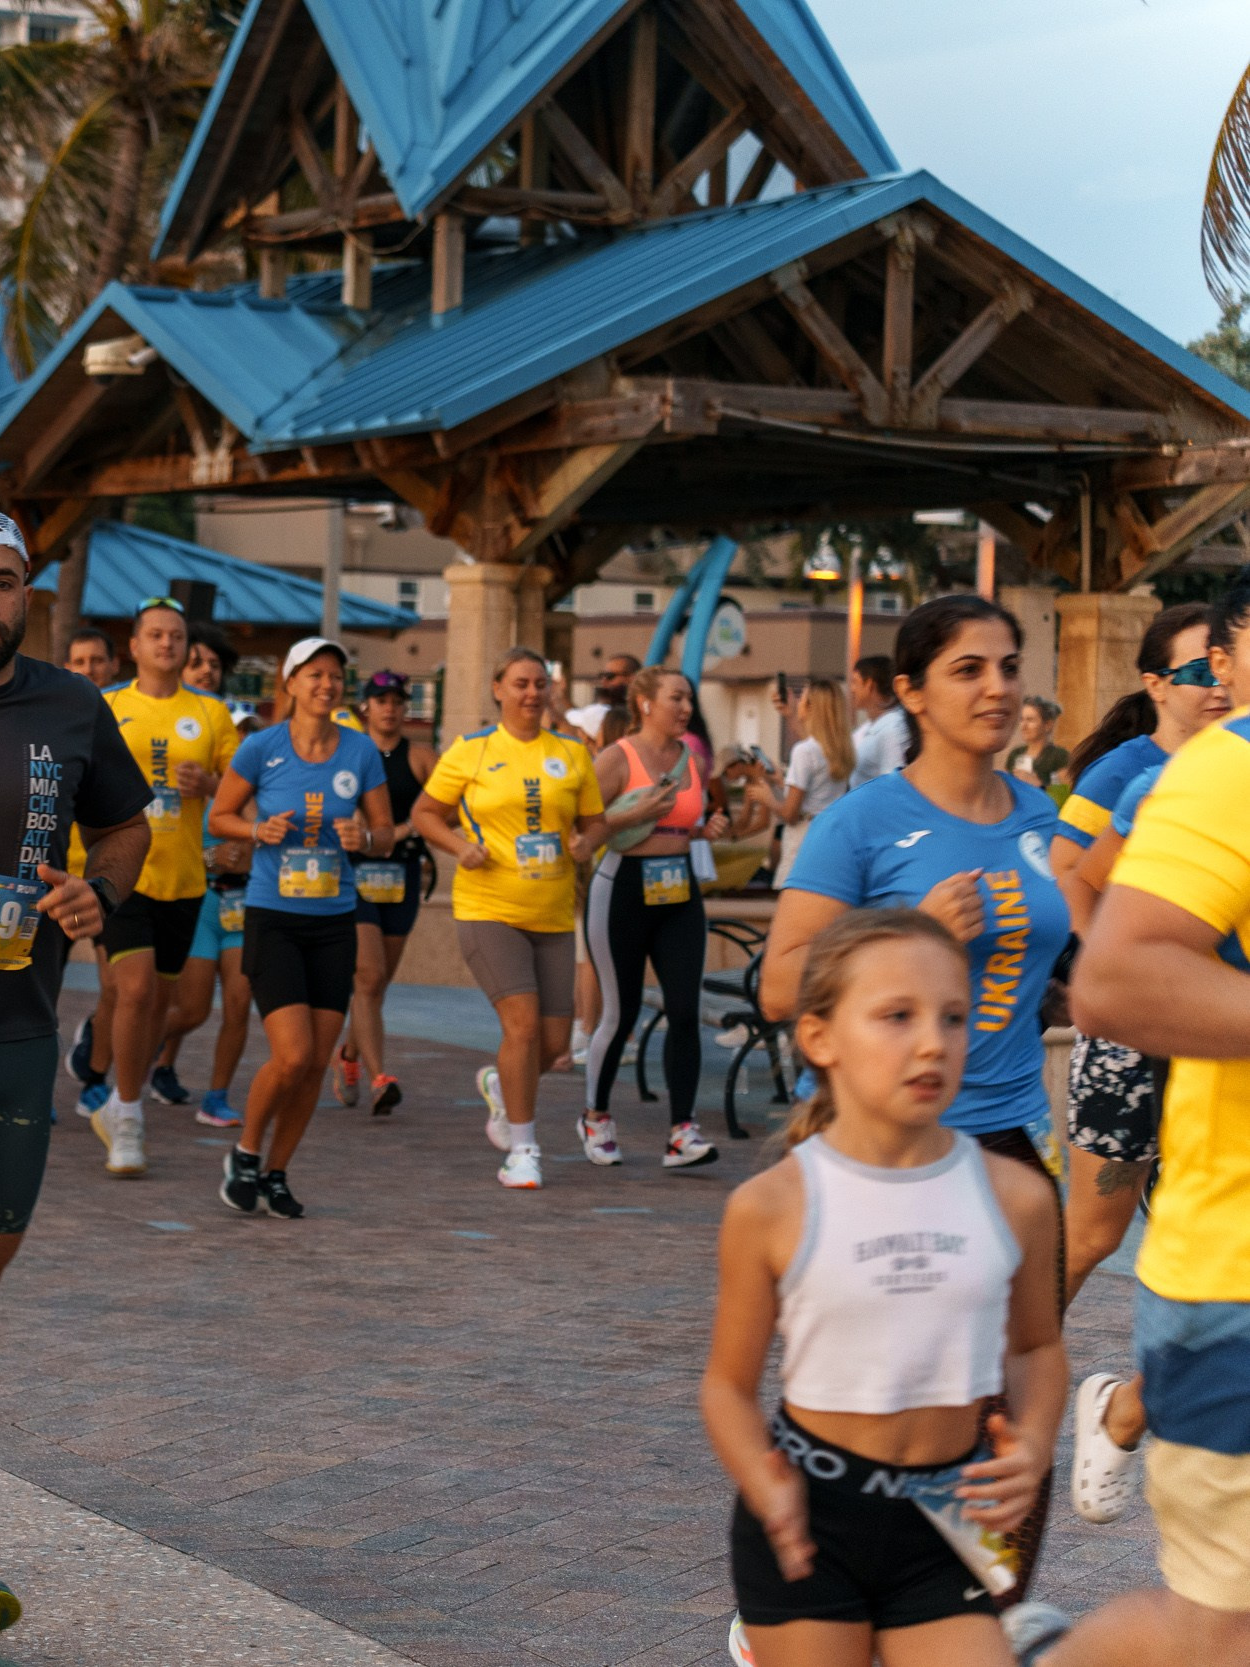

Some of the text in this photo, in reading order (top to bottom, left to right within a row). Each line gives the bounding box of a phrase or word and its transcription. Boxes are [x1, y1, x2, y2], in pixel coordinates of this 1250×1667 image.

[29, 744, 53, 762] LA
[30, 761, 63, 780] NYC
[30, 777, 59, 798] MIA
[29, 795, 55, 814] CHI
[26, 812, 58, 831] BOS
[22, 829, 51, 847] ATL
[18, 846, 51, 864] DAL
[17, 863, 41, 881] FT
[306, 859, 319, 881] 8
[974, 869, 1031, 1032] UKRAINE
